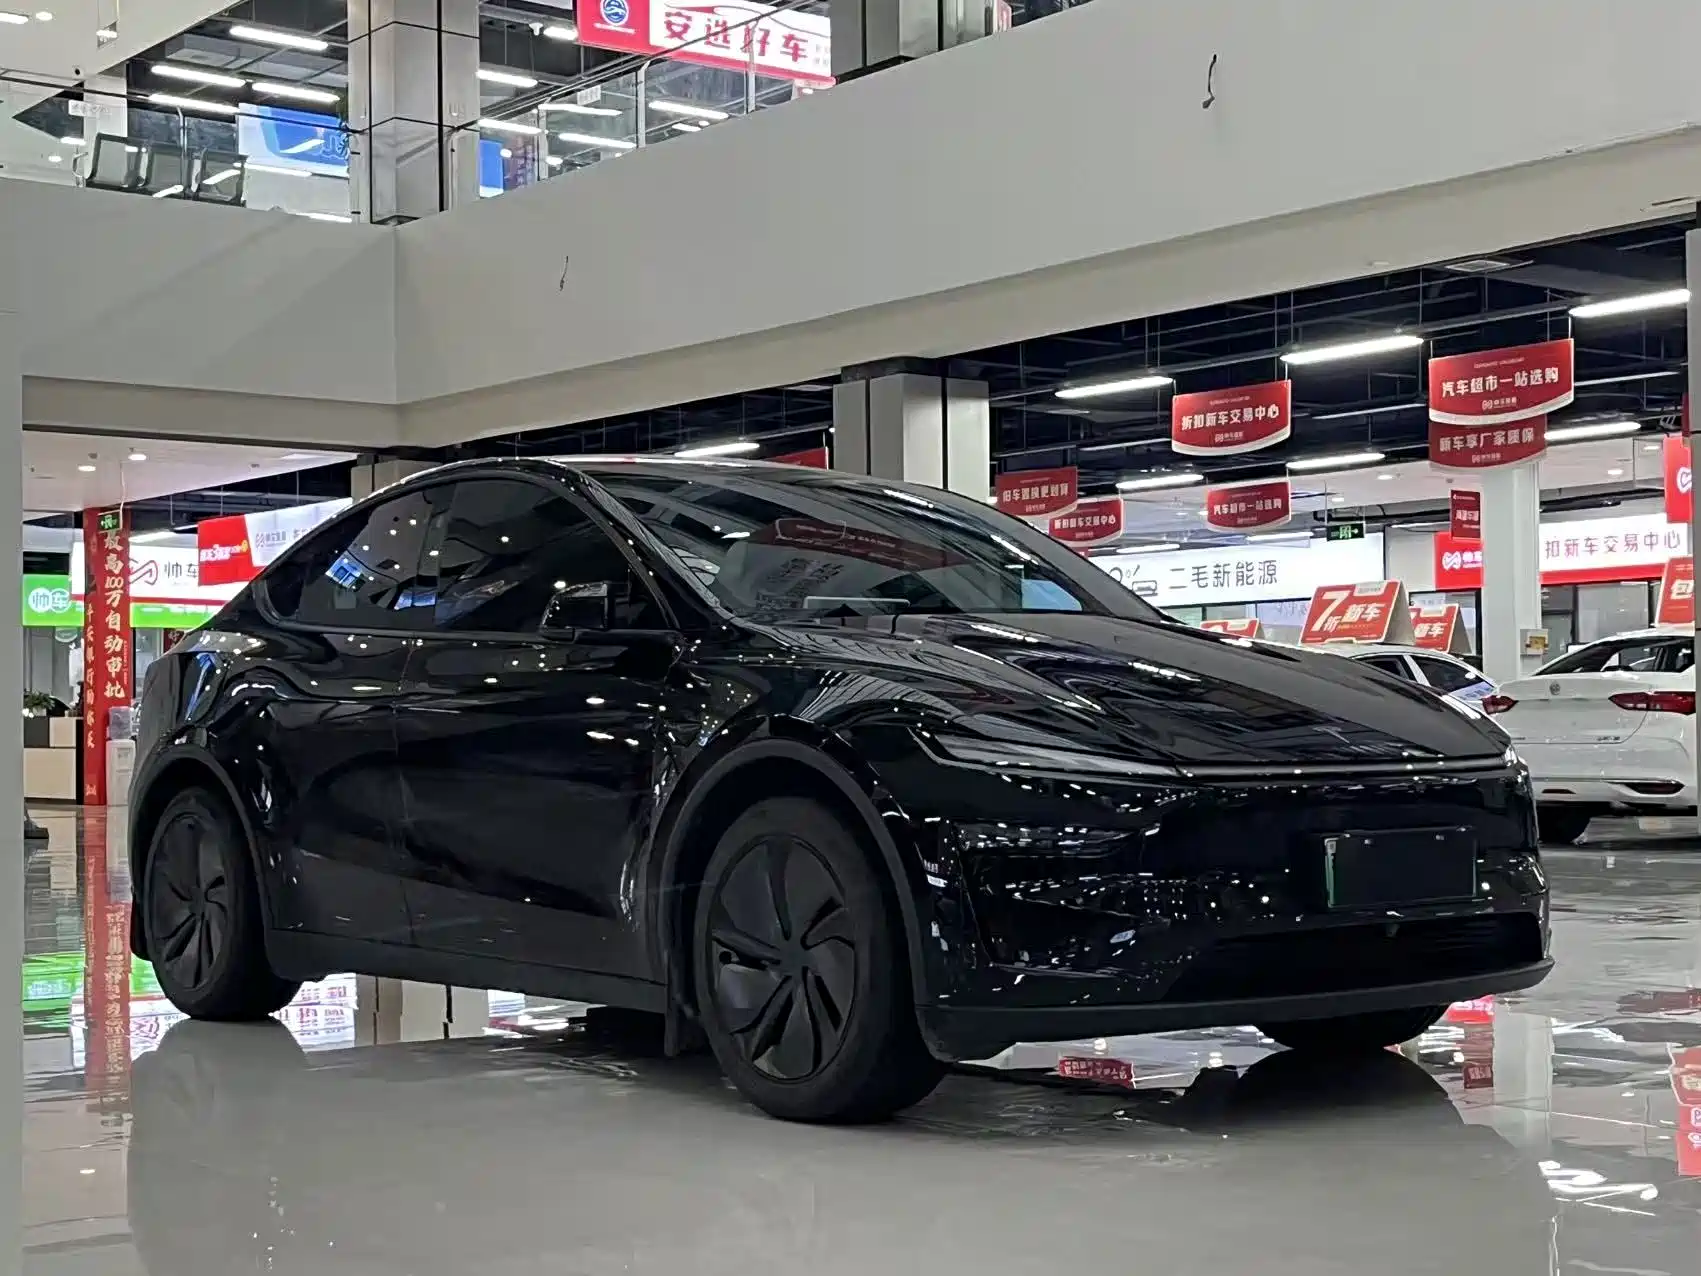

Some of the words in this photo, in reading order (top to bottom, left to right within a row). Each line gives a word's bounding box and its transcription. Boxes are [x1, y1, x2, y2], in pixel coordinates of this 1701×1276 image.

[664, 11, 808, 62] 安选好车
[1442, 367, 1559, 397] 汽车超市一站选购
[1181, 403, 1280, 430] 折扣新车交易中心
[1439, 427, 1535, 452] 新车享厂家质保
[1545, 530, 1681, 559] 扣新车交易中心
[1169, 559, 1278, 589] 二毛新能源
